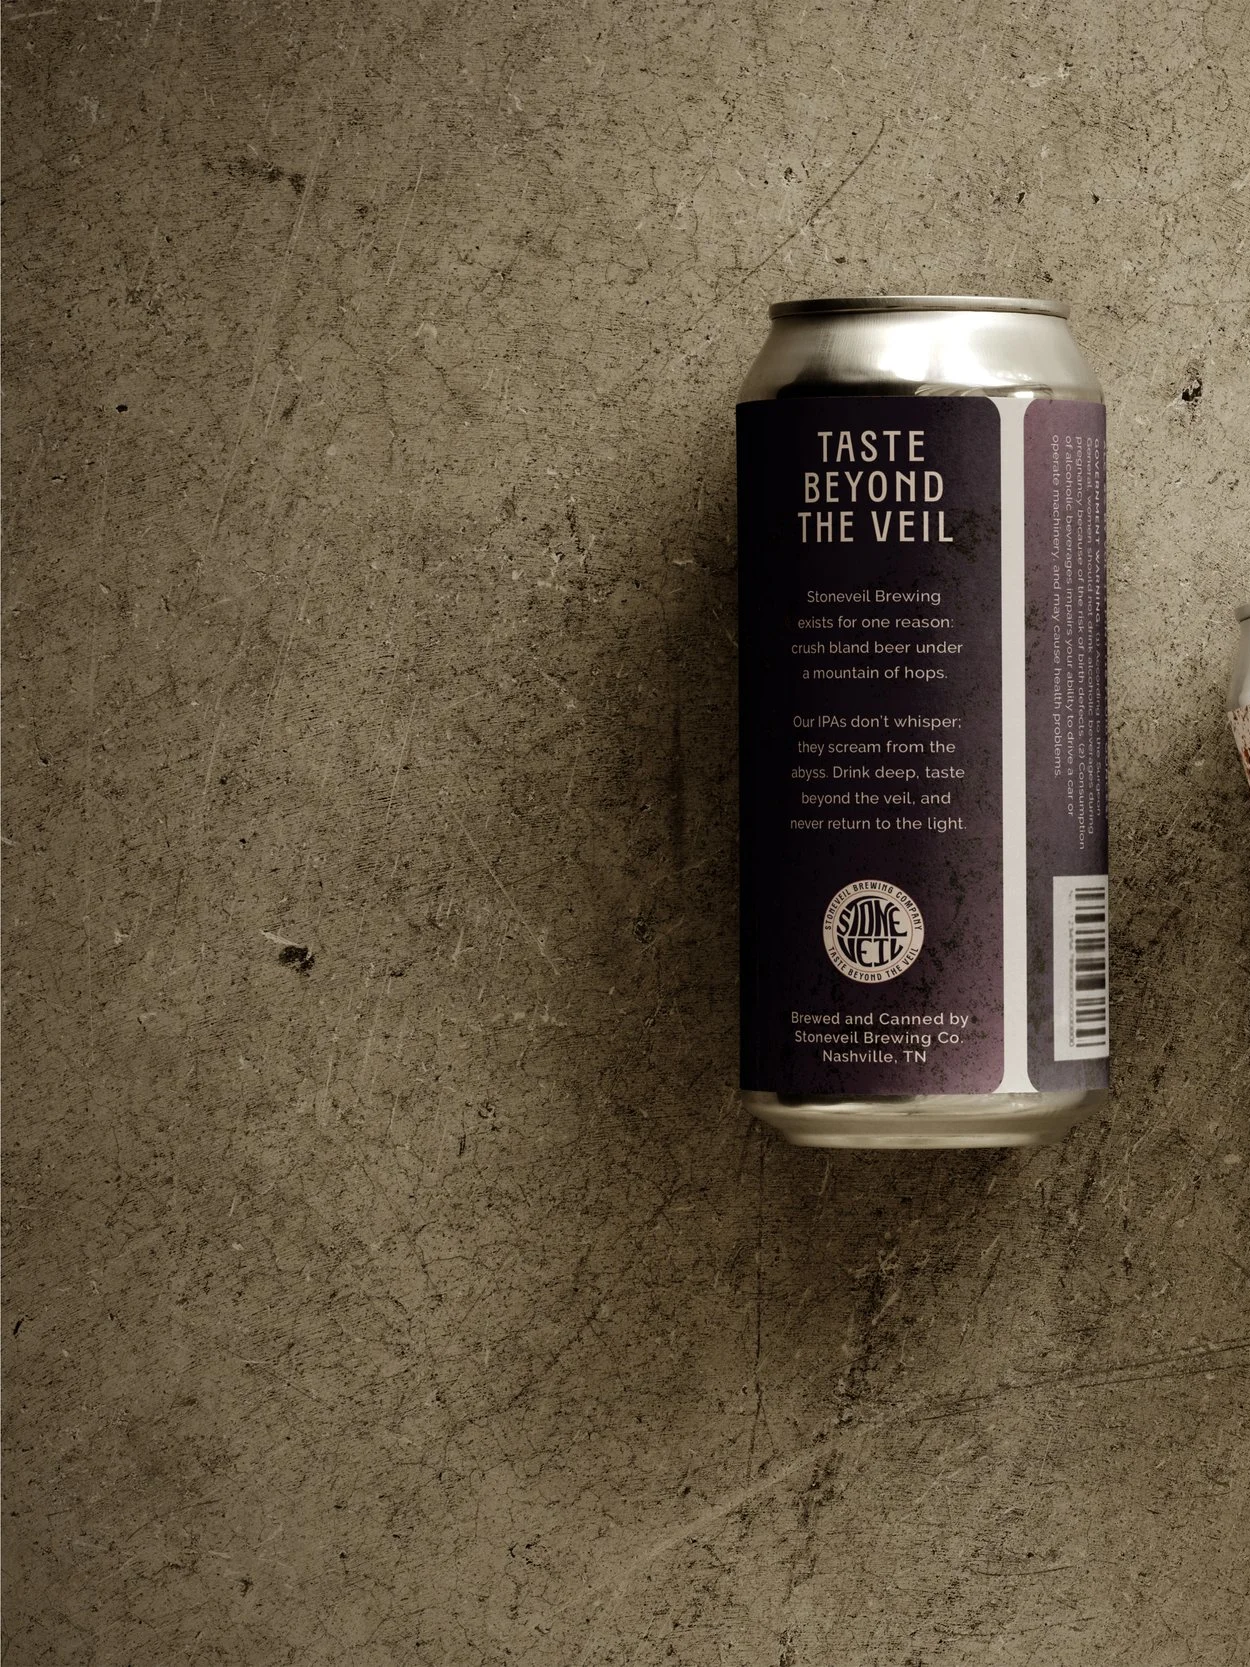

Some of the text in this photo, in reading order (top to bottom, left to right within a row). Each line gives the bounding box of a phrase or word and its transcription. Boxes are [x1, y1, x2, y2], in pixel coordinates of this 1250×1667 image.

[818, 430, 924, 462] TASTE
[1066, 436, 1073, 448] of
[1051, 435, 1060, 485] operate
[805, 471, 943, 503] BEYOND
[798, 511, 953, 542] THE VEIL
[1065, 516, 1073, 584] beverages
[1053, 565, 1061, 589] and
[1078, 569, 1084, 582] of
[808, 590, 940, 605] Stoneveil Brewing
[1052, 594, 1060, 621] may
[1065, 589, 1073, 635] impairs
[798, 616, 953, 628] exists for one reason:
[792, 641, 963, 654] crush bland beer under
[1078, 637, 1084, 650] of
[803, 666, 947, 682] a mountain of hops.
[1054, 668, 1062, 709] health
[1065, 672, 1074, 711] ability
[793, 715, 961, 730] Our IPAs don't whisper;
[1067, 716, 1074, 727] to
[1096, 720, 1101, 733] to
[798, 740, 955, 756] they scream from the
[792, 766, 965, 781] abyss. Drink deep, taste
[802, 792, 950, 807] beyond the veil, and
[1068, 803, 1073, 816] or
[791, 817, 966, 833] never return to the light.
[825, 882, 922, 931] STONEVEIL BREWING COMPANY
[837, 895, 907, 937] STONE
[837, 935, 903, 967] VEIL
[828, 947, 918, 981] TASTE BEYOND THE VEIL
[792, 1012, 968, 1028] Brewed and Canned by
[795, 1031, 963, 1047] Stoneveil Brewing Co.
[823, 1050, 926, 1063] Nashville, TN
